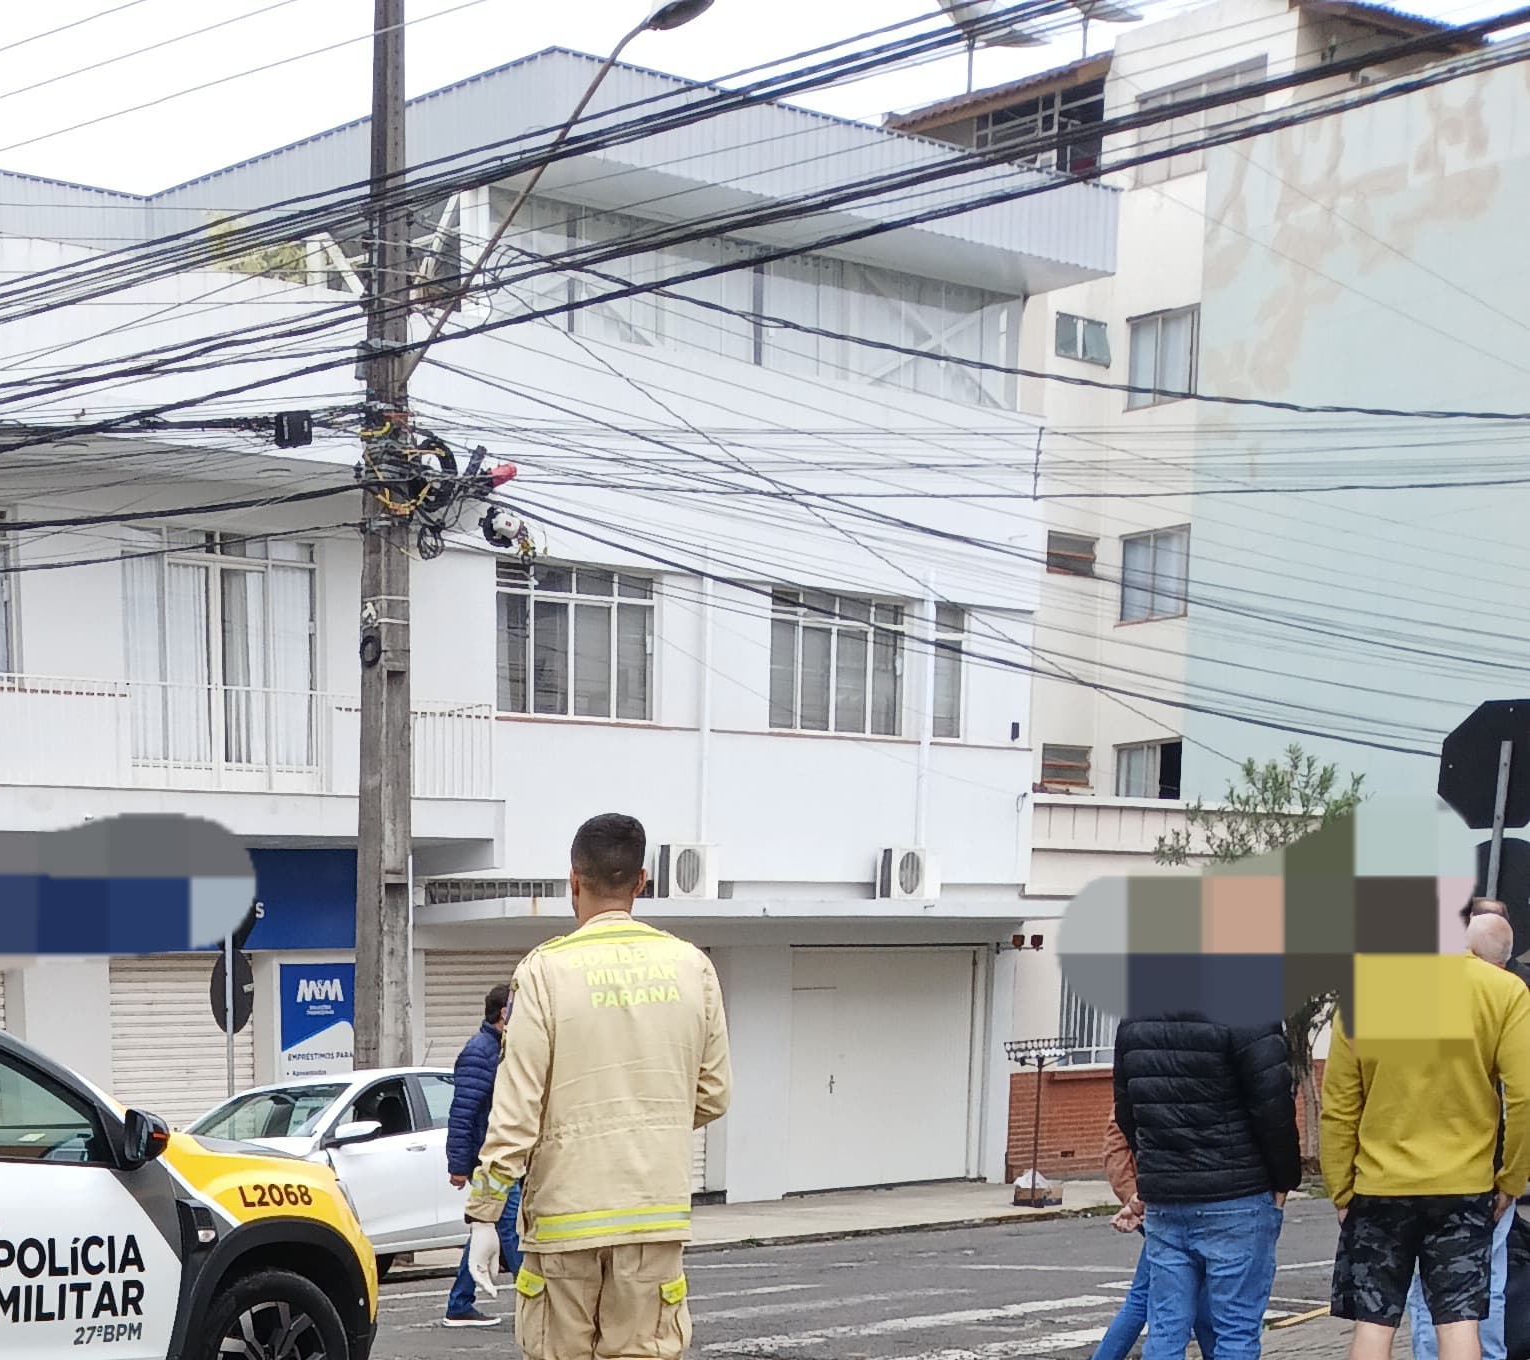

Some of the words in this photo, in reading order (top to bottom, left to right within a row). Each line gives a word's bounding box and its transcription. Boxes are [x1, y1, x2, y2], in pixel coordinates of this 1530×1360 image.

[568, 946, 683, 969] BOMBE
[586, 963, 678, 987] MILITAR
[238, 1183, 313, 1208] L2068
